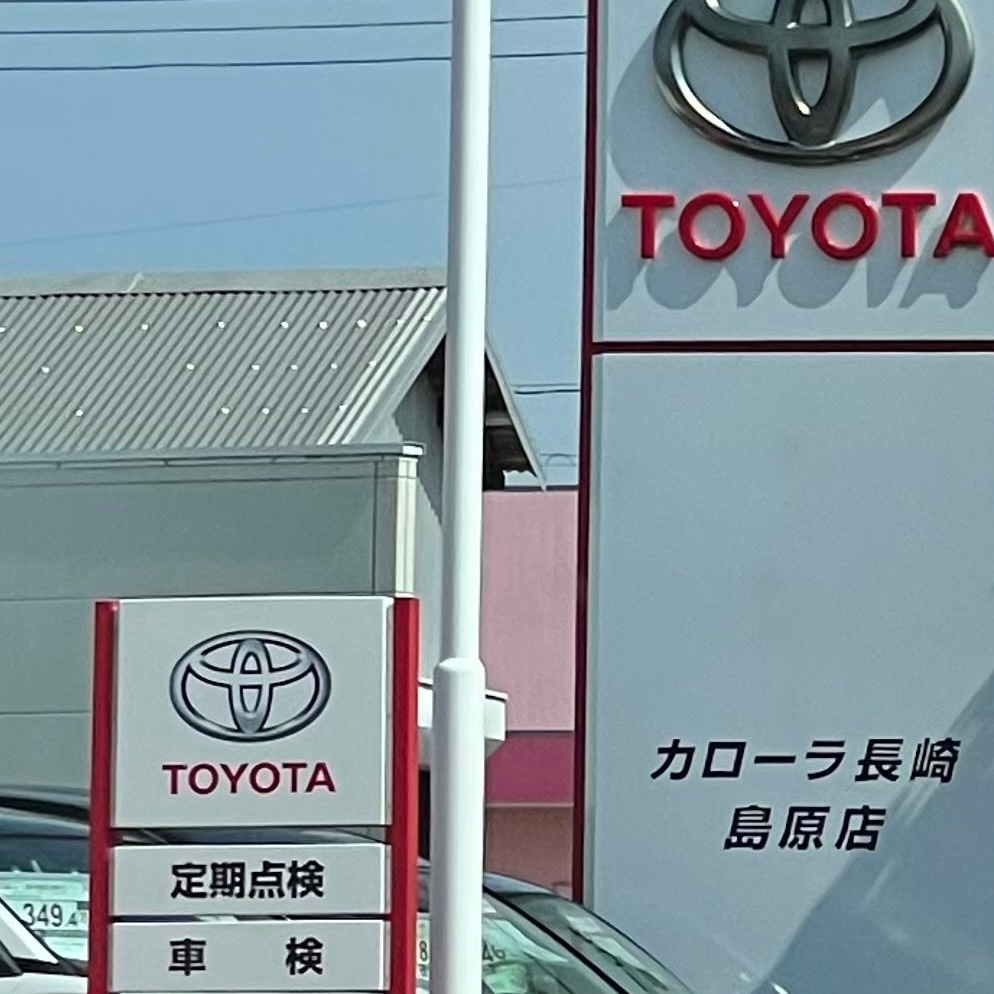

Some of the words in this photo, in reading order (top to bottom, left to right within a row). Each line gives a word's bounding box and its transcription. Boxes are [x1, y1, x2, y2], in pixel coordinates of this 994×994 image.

[162, 762, 336, 794] TOYOTA
[651, 738, 961, 783] カローラ長崎
[724, 805, 886, 851] 島原店
[171, 860, 325, 899] 定期点検
